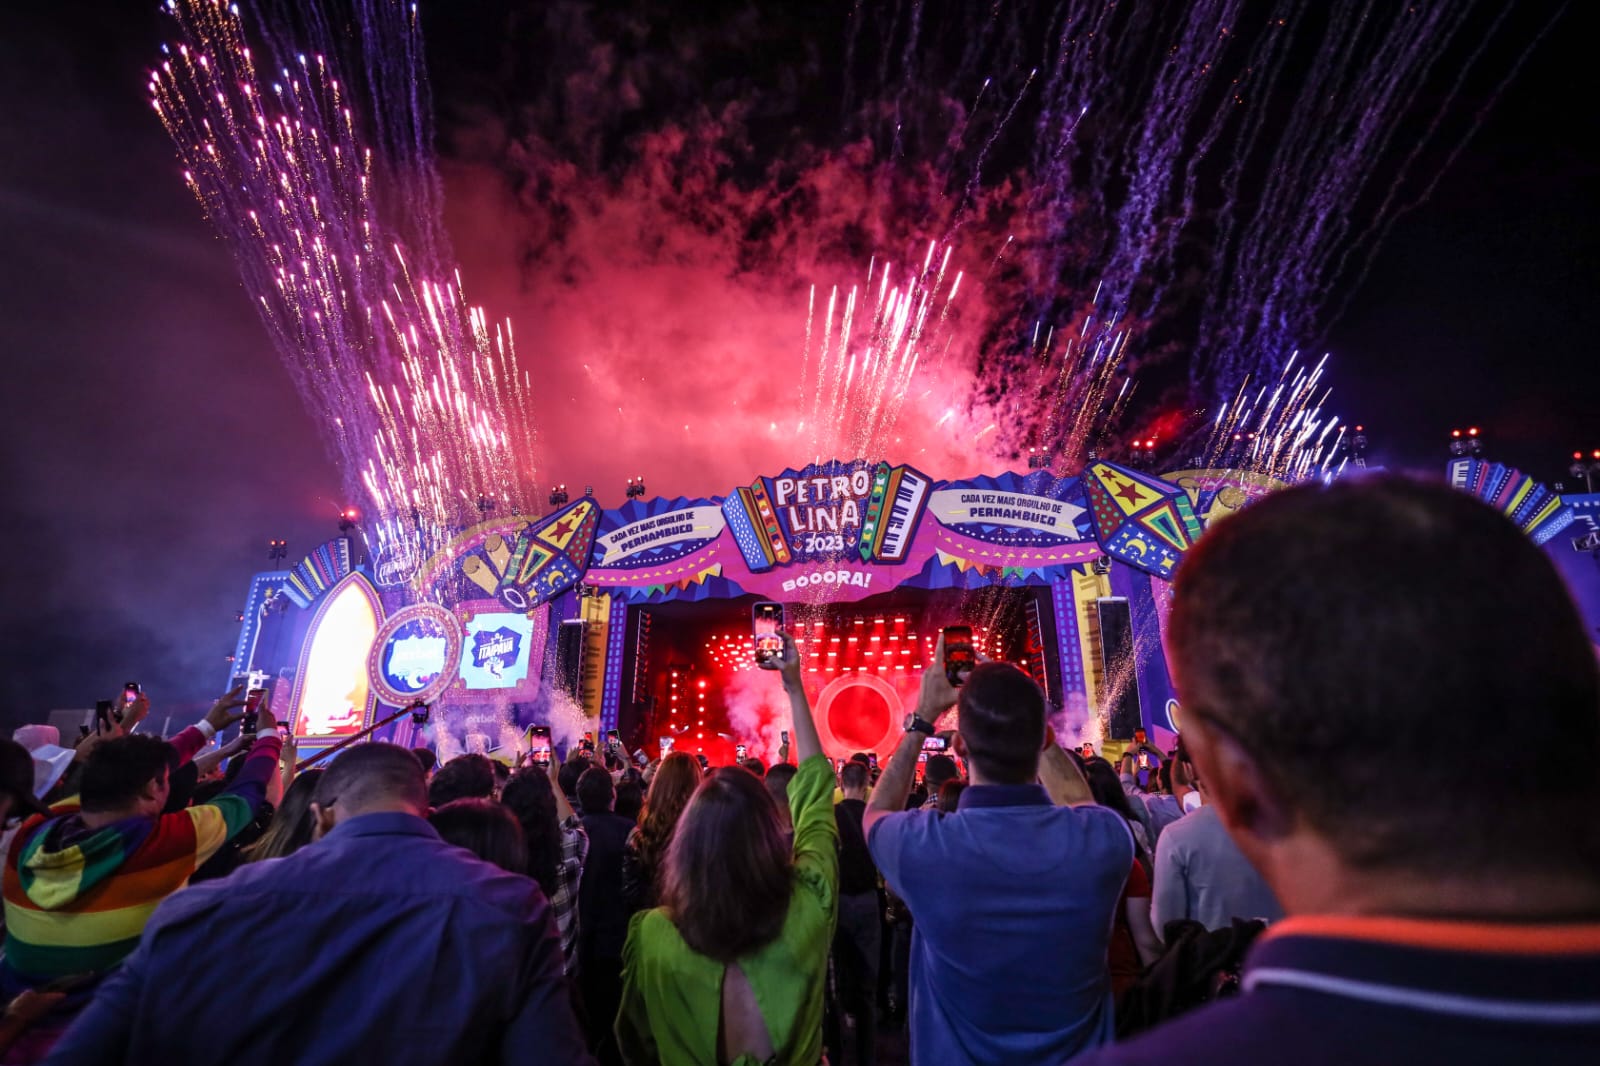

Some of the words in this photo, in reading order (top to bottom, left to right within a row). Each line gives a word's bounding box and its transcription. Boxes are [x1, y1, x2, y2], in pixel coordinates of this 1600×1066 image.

[776, 470, 870, 505] PETRO
[961, 494, 980, 504] CADA
[982, 494, 996, 504] VEZ
[997, 496, 1016, 506] MAIS
[1017, 498, 1050, 511] ORGULHO
[1051, 504, 1062, 513] DE
[789, 500, 859, 531] LINA
[970, 507, 1056, 526] PERNAMBUCO
[610, 531, 628, 543] CADA
[627, 524, 641, 536] VEZ
[640, 520, 656, 531] MAIS
[656, 512, 685, 526] ORGULHO
[685, 511, 694, 520] DE
[620, 524, 693, 552] PERNAMBUCO
[805, 535, 844, 553] 2023
[782, 571, 872, 592] BOOORA!
[479, 640, 513, 660] ITAIPAVA
